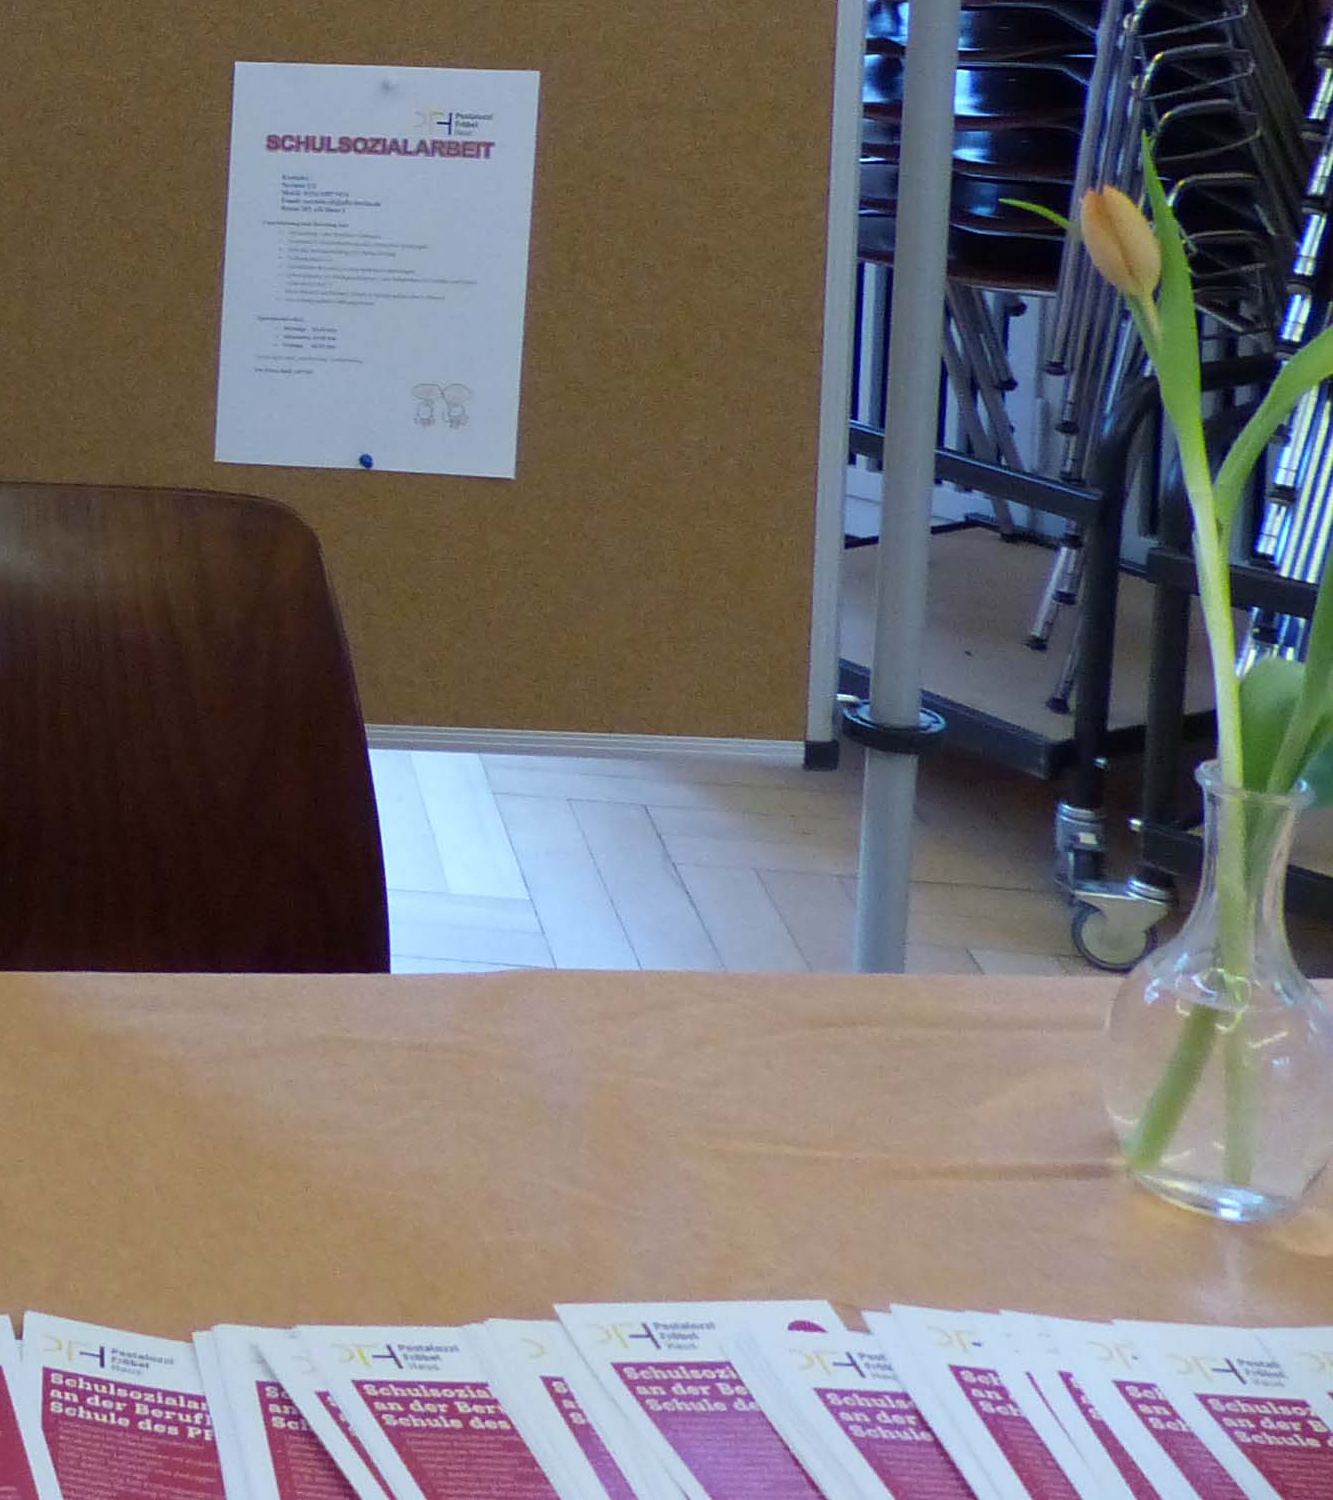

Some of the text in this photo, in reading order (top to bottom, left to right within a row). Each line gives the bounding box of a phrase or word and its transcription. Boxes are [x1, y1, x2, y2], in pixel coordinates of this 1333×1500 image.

[266, 134, 495, 159] SCHULSOZIALARBEIT
[635, 1382, 711, 1396] an der
[50, 1389, 79, 1402] an
[85, 1393, 127, 1412] der
[374, 1399, 450, 1413] an der
[646, 1398, 727, 1412] Schule
[50, 1401, 131, 1428] Schule
[136, 1418, 179, 1435] des
[382, 1414, 511, 1429] Schule des
[840, 1411, 872, 1424] an
